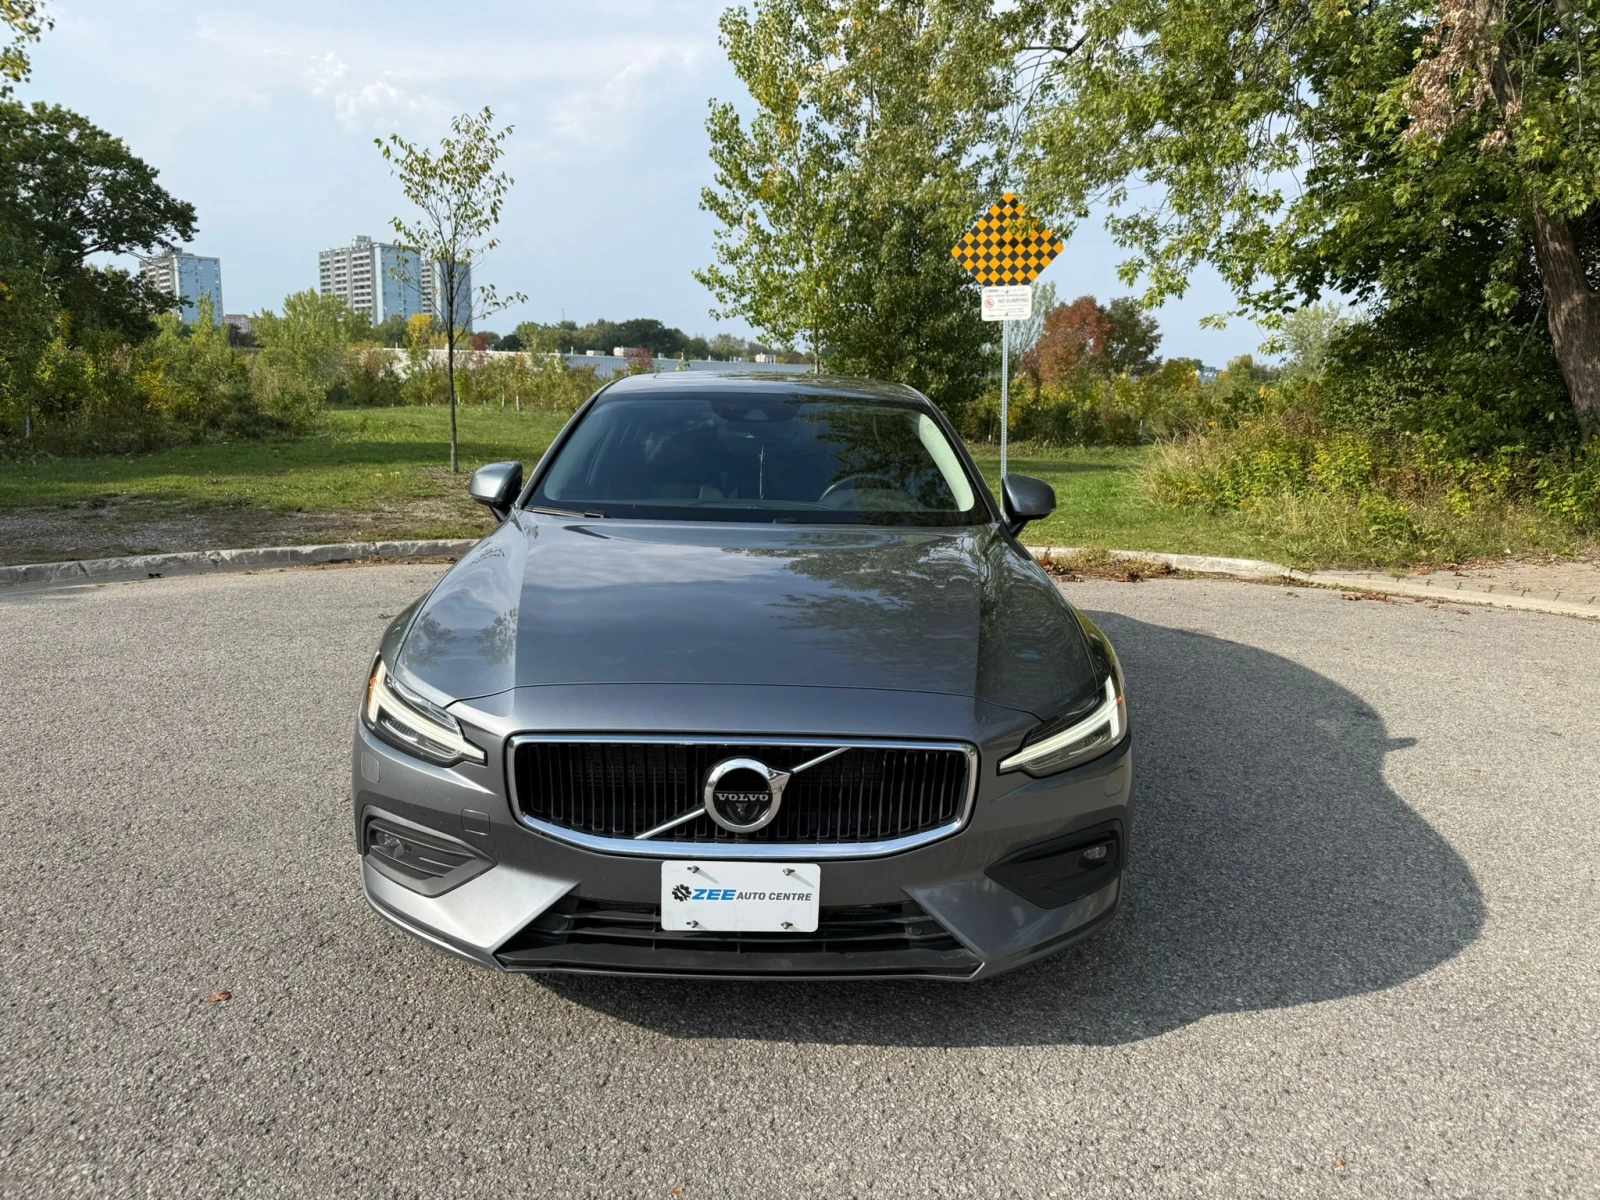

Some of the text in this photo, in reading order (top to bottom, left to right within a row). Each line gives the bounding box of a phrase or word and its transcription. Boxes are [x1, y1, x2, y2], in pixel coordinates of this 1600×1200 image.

[716, 793, 769, 801] VOLVO
[692, 889, 812, 901] ZEE AUTO CENTRE
